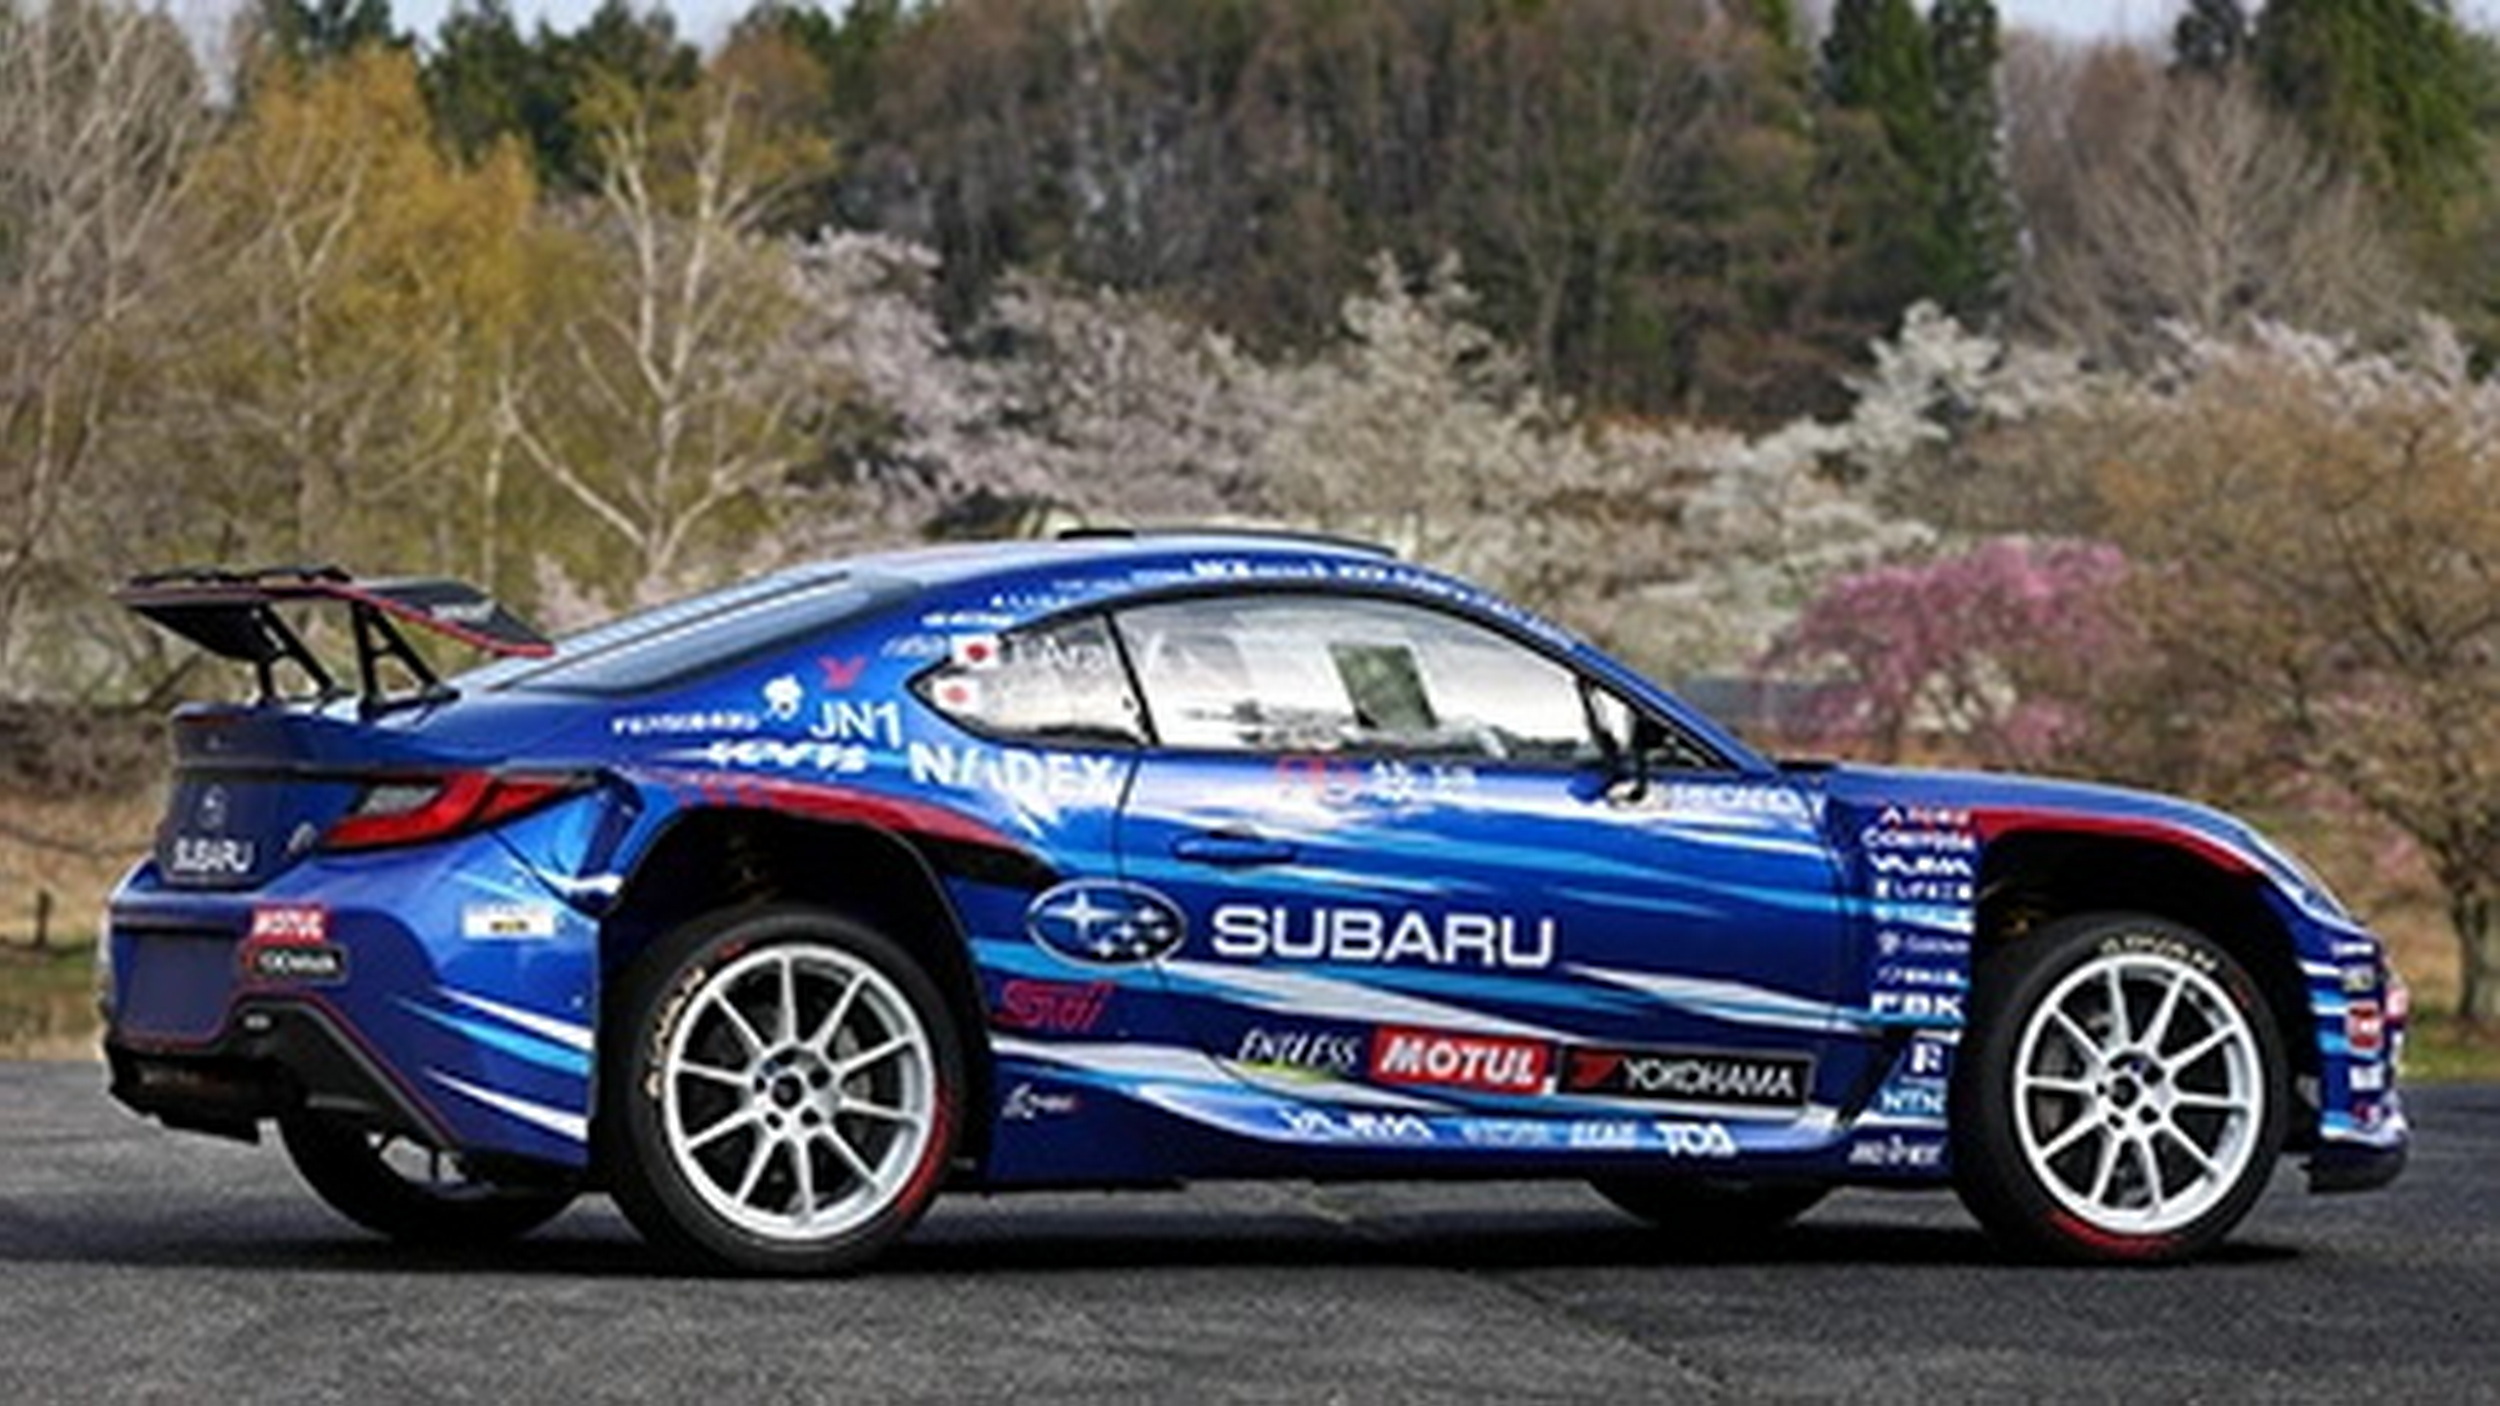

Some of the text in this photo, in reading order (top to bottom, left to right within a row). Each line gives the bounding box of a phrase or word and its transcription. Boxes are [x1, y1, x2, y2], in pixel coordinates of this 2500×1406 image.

[809, 700, 902, 749] JN1
[1211, 905, 1554, 967] SUBARU
[1379, 1034, 1536, 1085] MOTUL
[1622, 1058, 1797, 1099] YOKOHAMA
